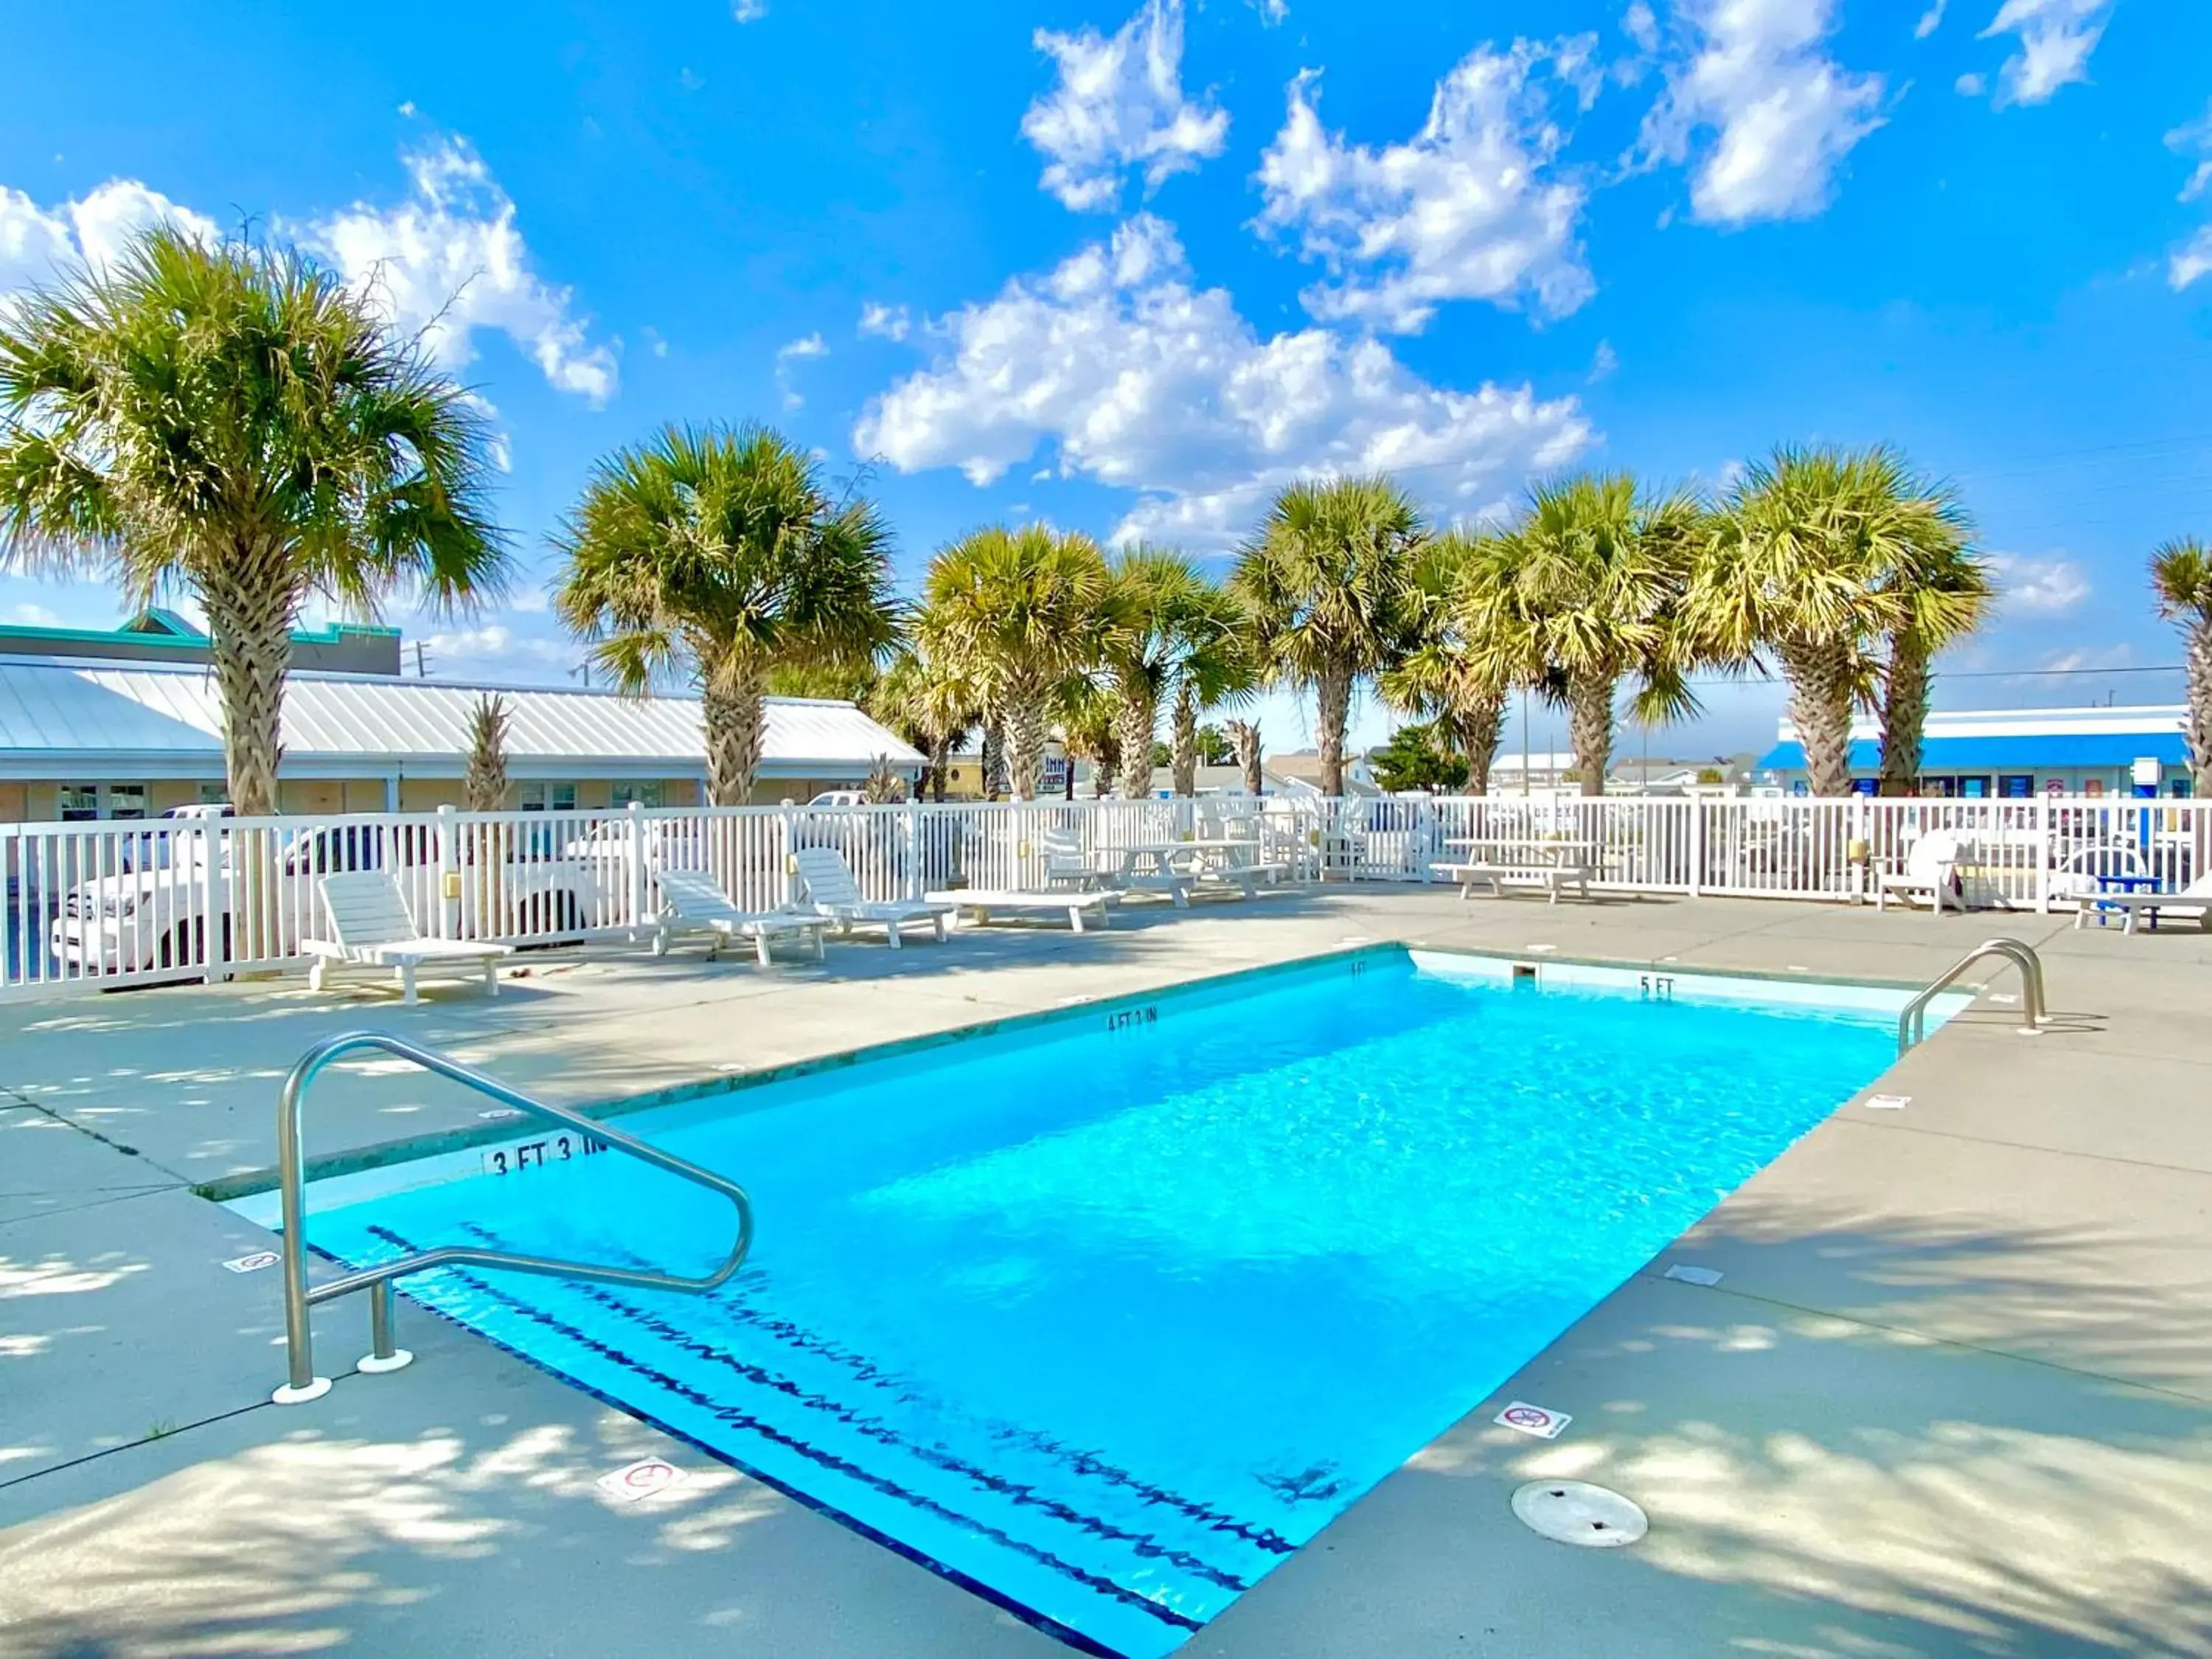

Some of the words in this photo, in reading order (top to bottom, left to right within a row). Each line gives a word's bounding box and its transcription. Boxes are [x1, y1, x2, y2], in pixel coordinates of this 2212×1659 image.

[1046, 757, 1065, 773] INN
[1641, 976, 1649, 995] 5
[1657, 978, 1674, 998] FT
[1108, 1015, 1115, 1032] 4
[1119, 1012, 1132, 1029] FT
[1146, 1006, 1157, 1022] IN
[494, 1152, 507, 1175] 3
[518, 1141, 546, 1171] FT
[558, 1136, 571, 1161] 3
